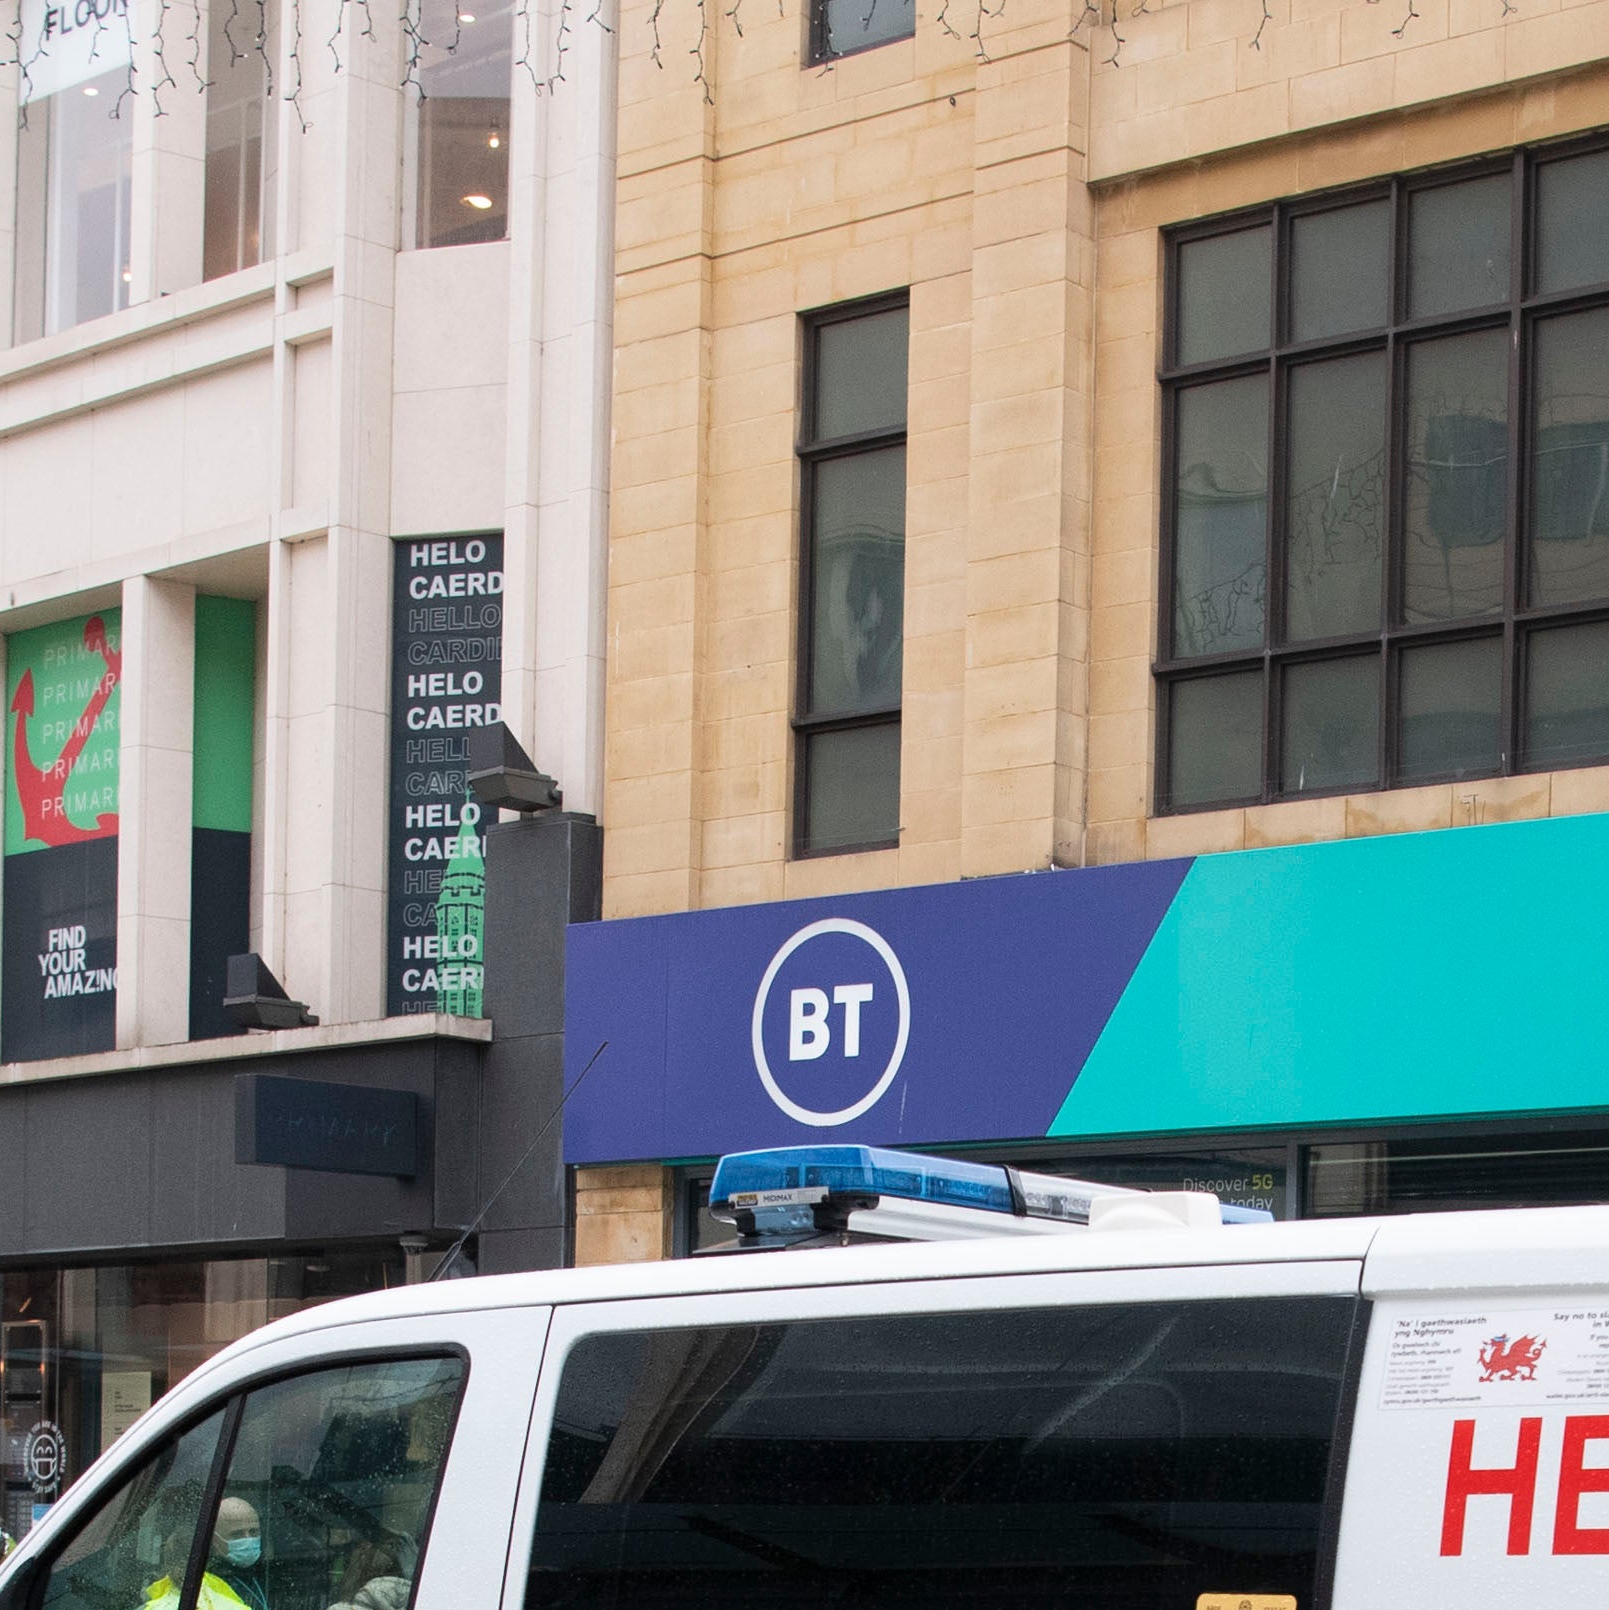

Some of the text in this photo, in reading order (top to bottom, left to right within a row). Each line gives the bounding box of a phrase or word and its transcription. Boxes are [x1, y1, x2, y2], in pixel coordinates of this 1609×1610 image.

[410, 540, 486, 567] HELO
[408, 604, 502, 632] HELLO
[408, 637, 502, 665] CARDI
[408, 671, 483, 698] HELO
[42, 710, 119, 744] PRIMAR
[406, 737, 471, 764] HELL
[41, 749, 119, 782] PRIMAR
[41, 787, 119, 819] PRIMAR
[405, 802, 481, 829] HELO
[404, 835, 486, 861] CAER
[49, 925, 86, 952] FIND
[403, 935, 478, 959] HELO
[38, 949, 86, 976] YOUR
[402, 968, 484, 991] CAER
[789, 983, 873, 1062] BT
[1183, 1174, 1274, 1192] Discover 5G
